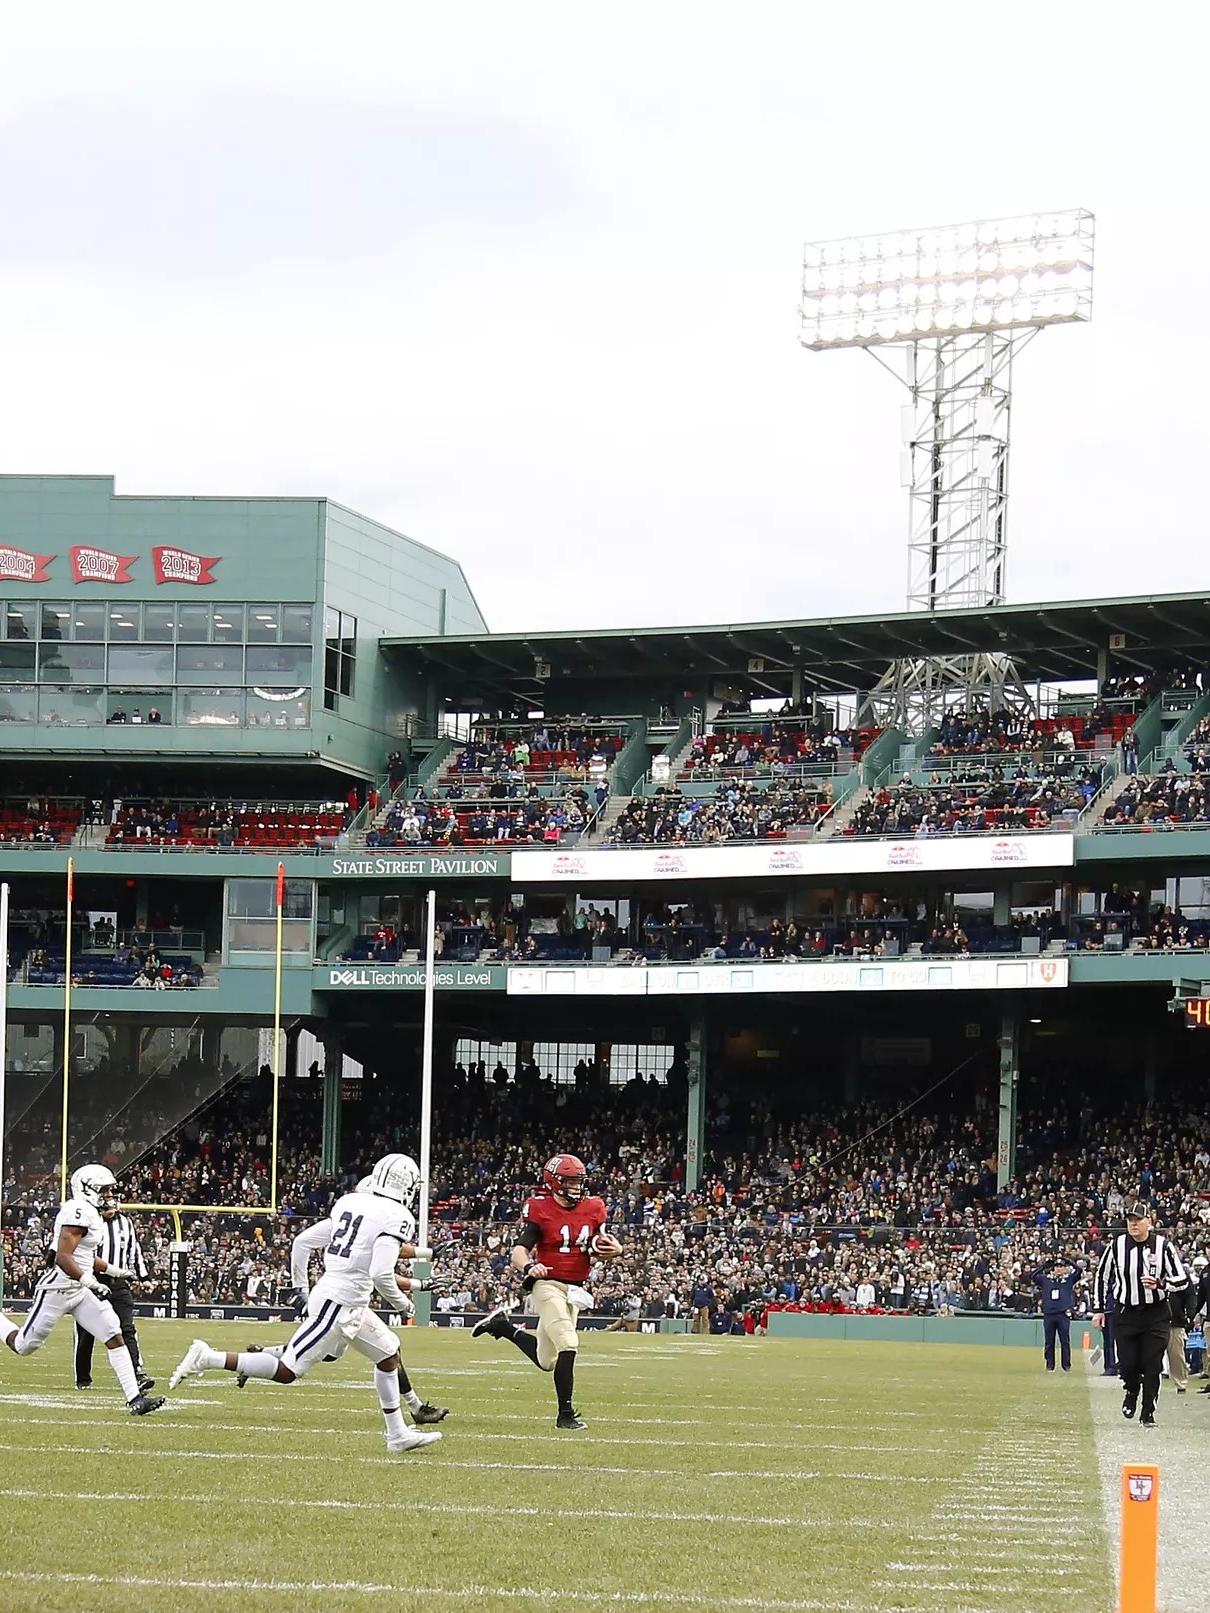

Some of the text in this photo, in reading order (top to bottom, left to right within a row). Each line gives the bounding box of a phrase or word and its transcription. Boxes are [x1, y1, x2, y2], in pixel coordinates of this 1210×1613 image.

[77, 555, 119, 574] 2007
[161, 556, 201, 576] 2013
[1, 569, 32, 579] CHAMPIONS
[82, 570, 115, 580] CHAMPIONS
[165, 571, 197, 581] CHAMPIONS
[332, 858, 498, 874] STATE STREET PAVILION
[330, 970, 491, 987] DELL Technoloies Level
[75, 1208, 81, 1219] 5
[327, 1211, 364, 1259] 21
[399, 1220, 412, 1237] 21
[559, 1225, 590, 1253] 14
[170, 1252, 179, 1318] HARVARD
[154, 1307, 166, 1318] M
[389, 1314, 402, 1326] M
[641, 1322, 656, 1334] M
